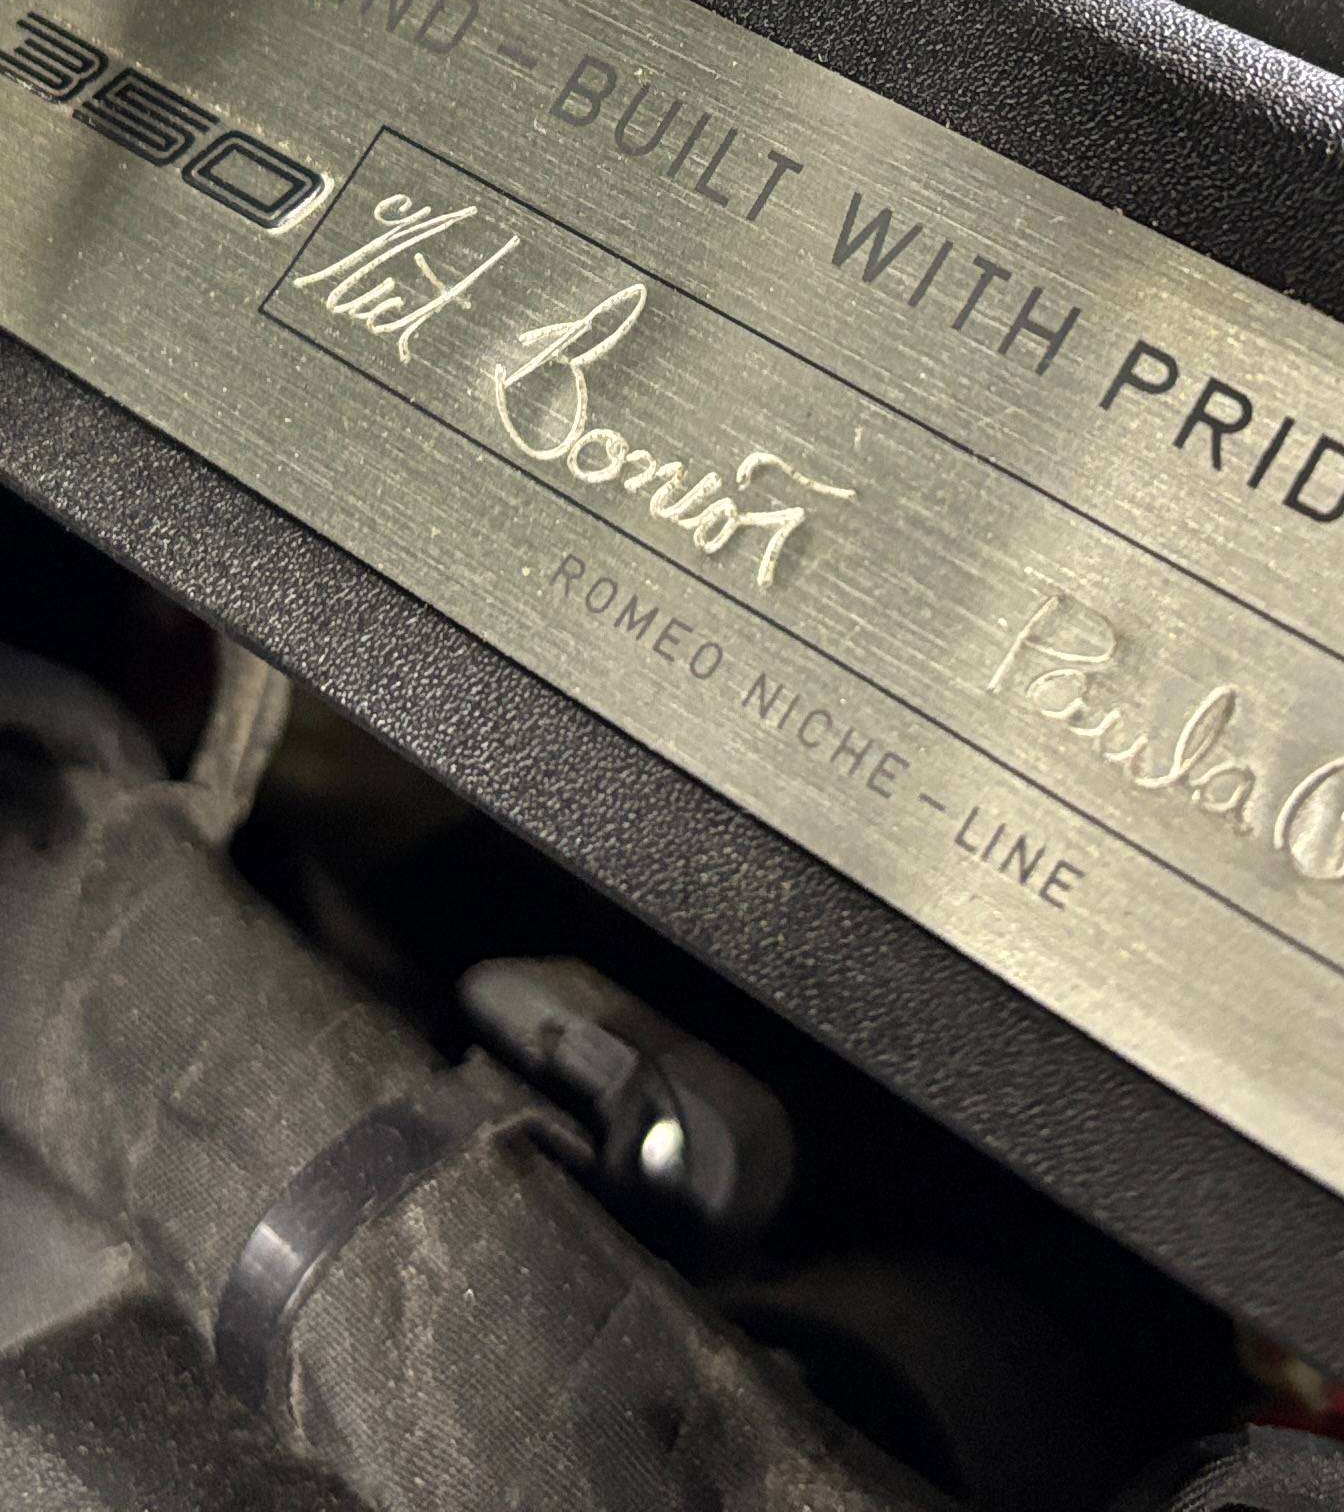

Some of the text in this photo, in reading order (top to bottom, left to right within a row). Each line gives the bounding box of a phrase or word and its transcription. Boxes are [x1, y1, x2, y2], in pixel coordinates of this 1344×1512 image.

[831, 191, 1082, 377] WITH
[549, 554, 724, 681] ROMEO
[986, 590, 1264, 836] Paula
